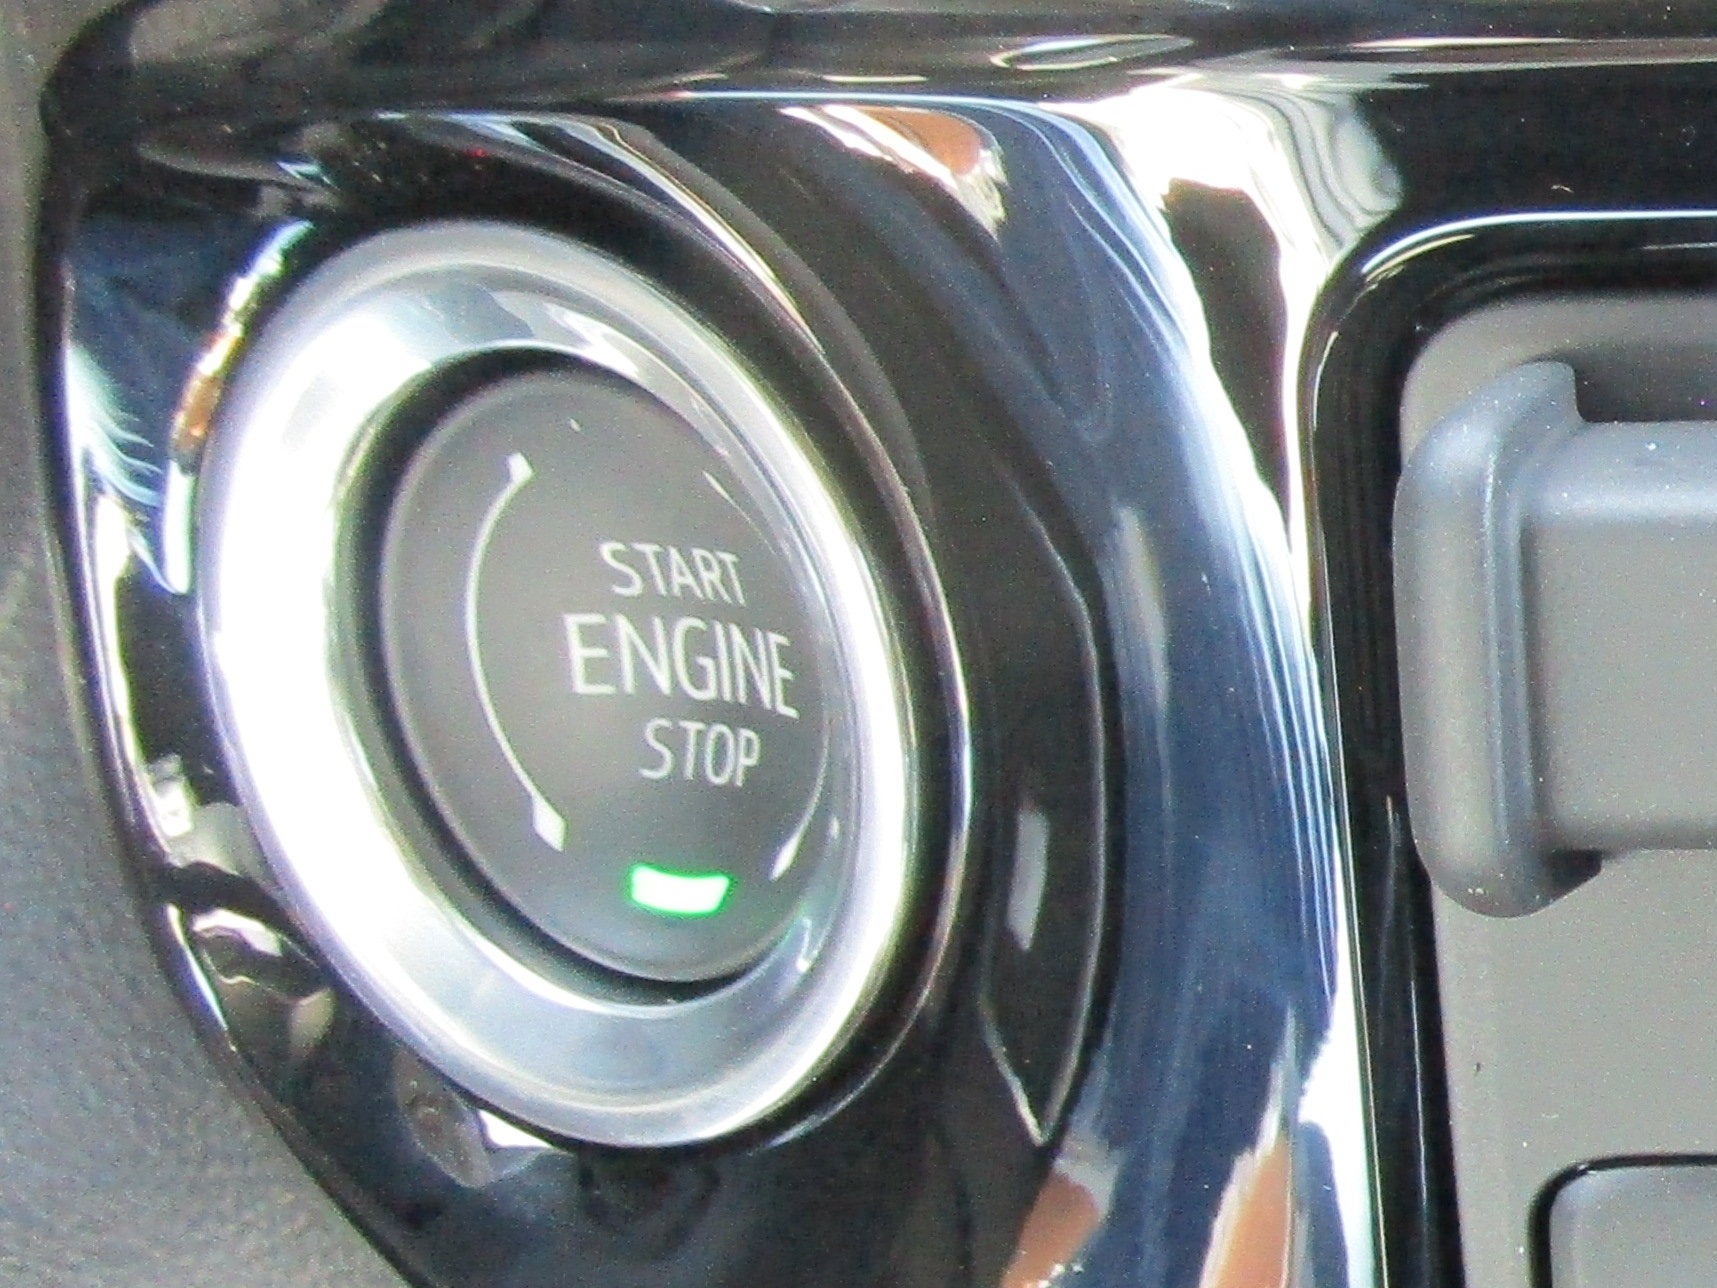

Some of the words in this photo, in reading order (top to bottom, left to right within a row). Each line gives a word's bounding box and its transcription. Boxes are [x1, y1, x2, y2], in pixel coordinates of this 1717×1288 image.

[600, 541, 746, 607] START
[563, 613, 800, 719] ENGINE
[639, 718, 761, 787] STOP
